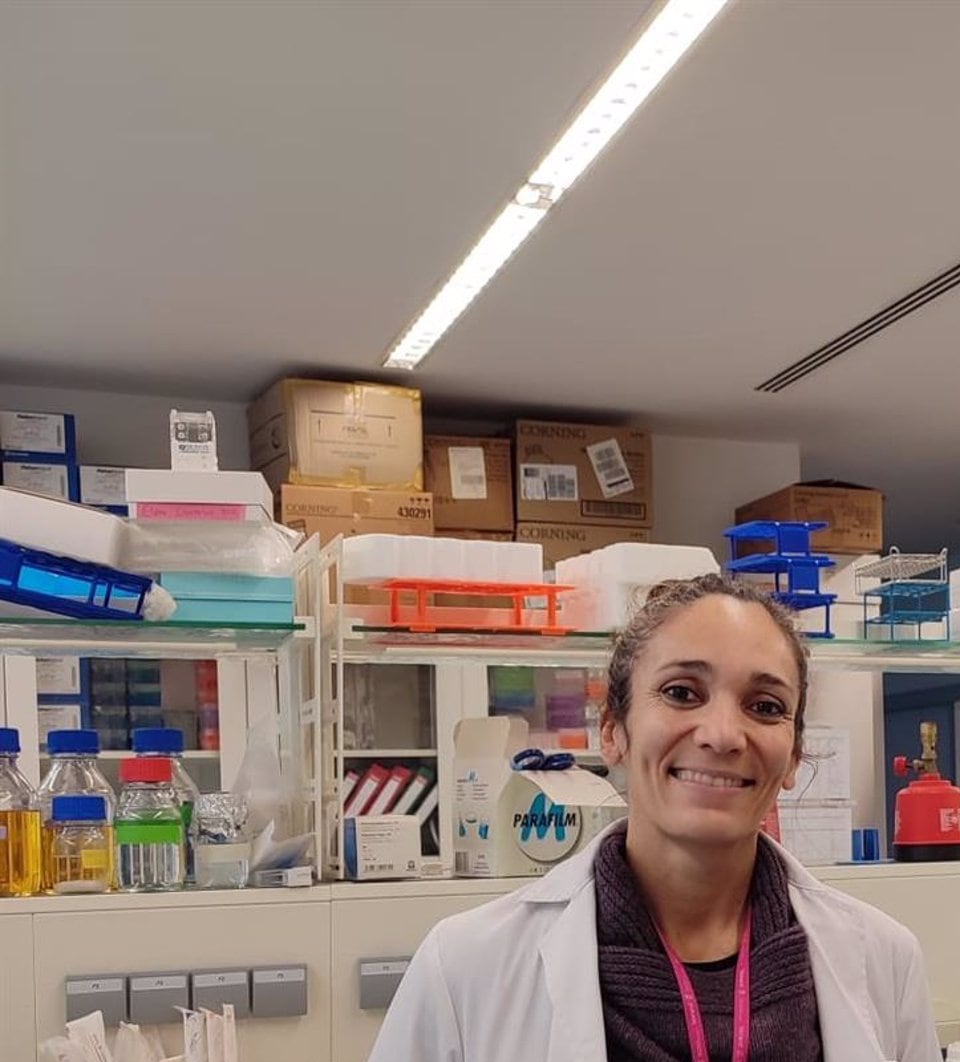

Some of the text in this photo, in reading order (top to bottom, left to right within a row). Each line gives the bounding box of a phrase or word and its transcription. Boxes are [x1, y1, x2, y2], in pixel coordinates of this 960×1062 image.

[520, 424, 587, 439] CORNING
[519, 527, 587, 542] CORNING
[513, 812, 577, 828] PARAFILM
